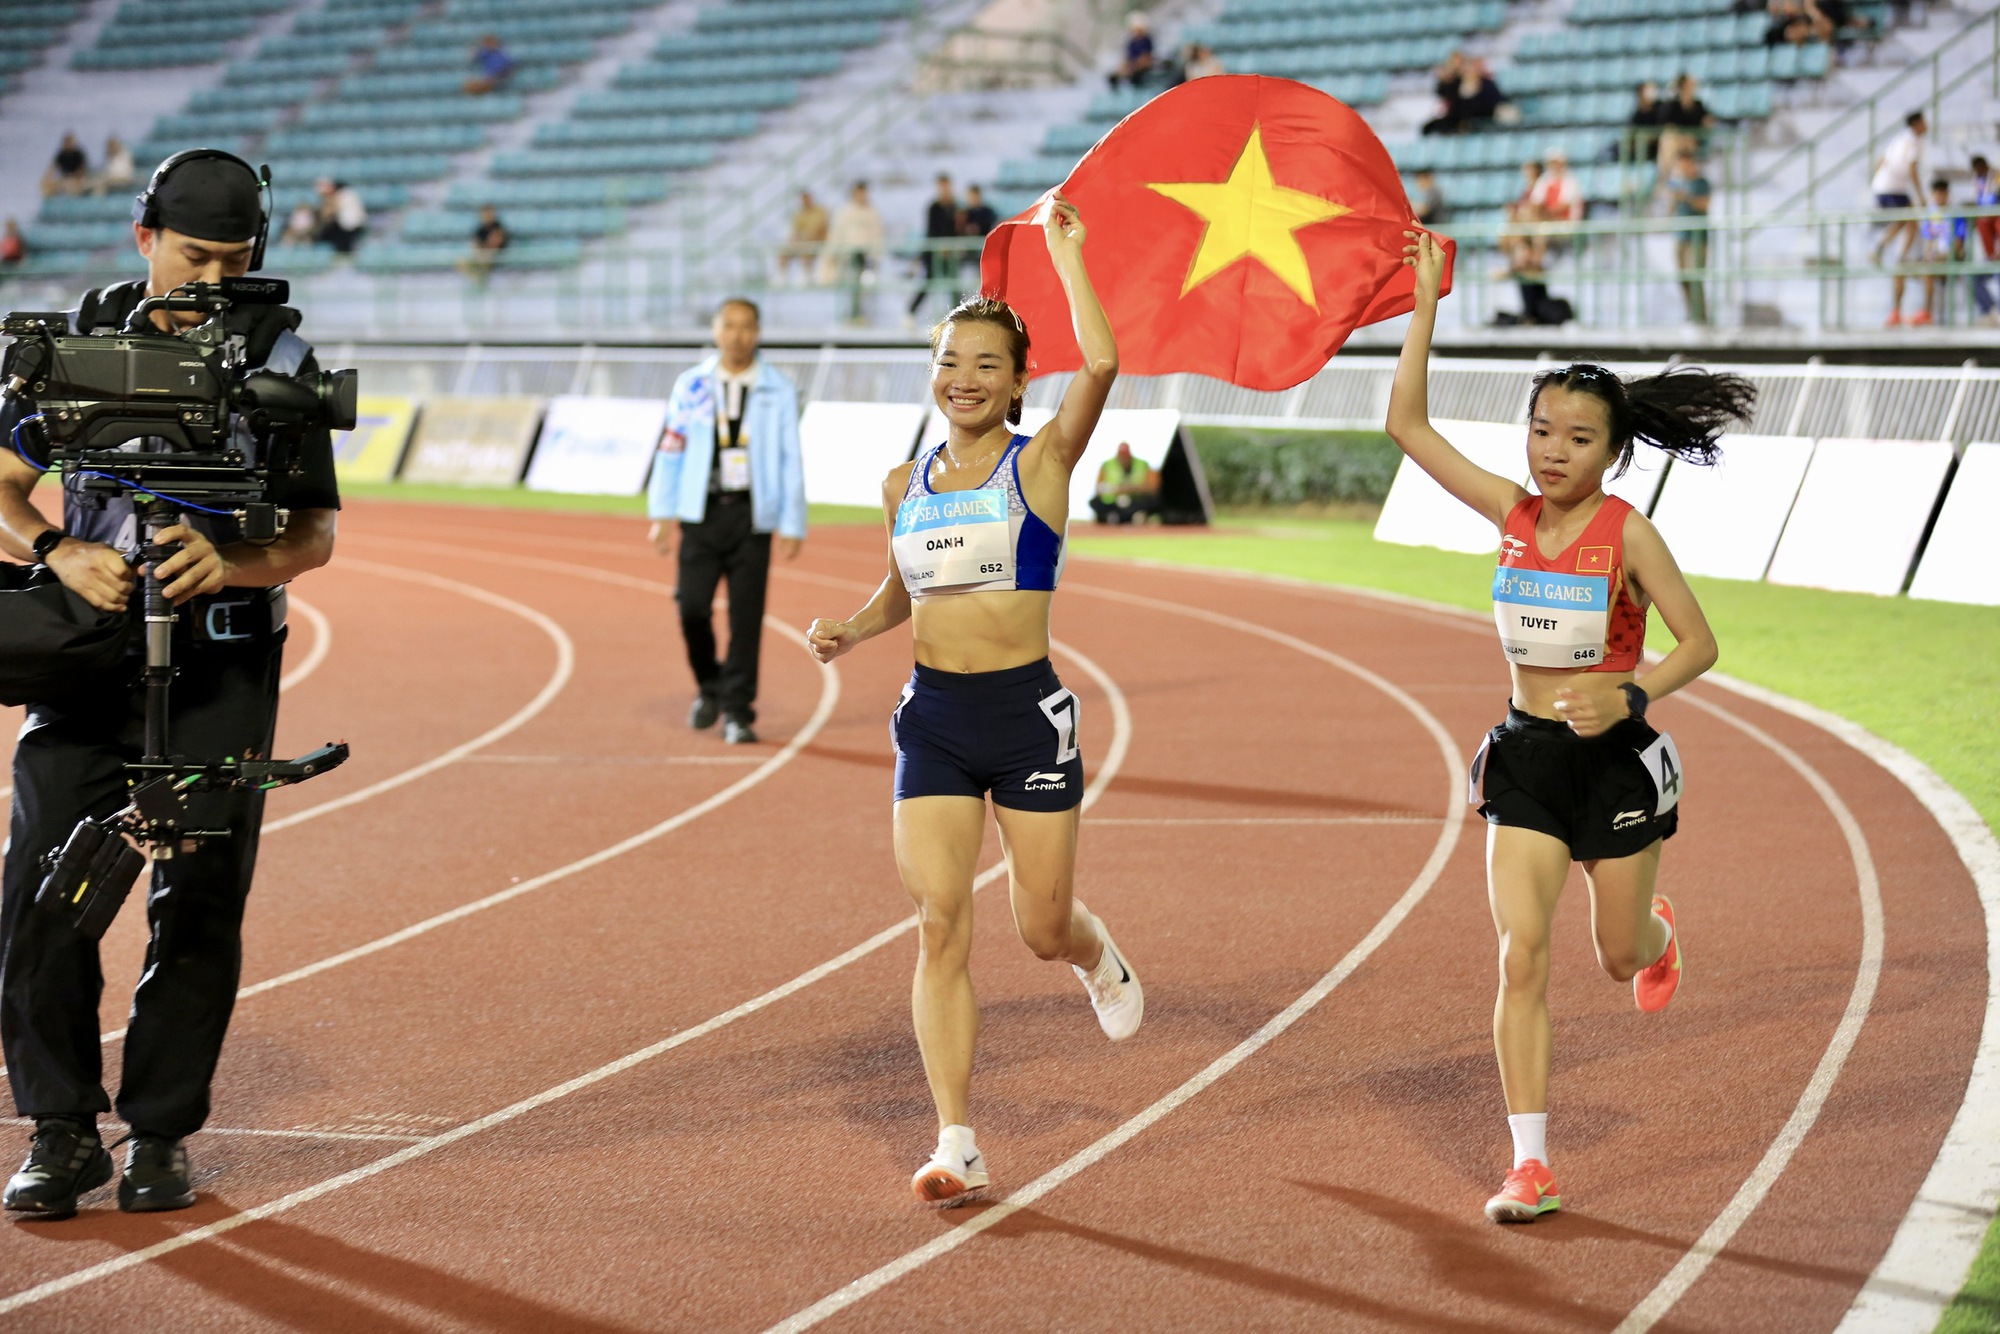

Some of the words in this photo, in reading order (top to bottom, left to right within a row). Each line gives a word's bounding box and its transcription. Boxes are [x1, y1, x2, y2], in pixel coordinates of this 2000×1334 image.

[189, 374, 196, 385] 1
[919, 505, 941, 523] SEA
[943, 500, 993, 518] GAMES
[926, 536, 964, 551] OANH
[980, 563, 1003, 574] 652
[1519, 581, 1541, 598] SEA
[1544, 584, 1593, 603] GAMES
[1520, 616, 1558, 631] TUYET
[1574, 649, 1596, 660] 646
[1051, 694, 1076, 750] 7
[1660, 745, 1679, 796] 4
[1024, 781, 1066, 791] LI-NING
[1613, 815, 1647, 830] LI-NING
